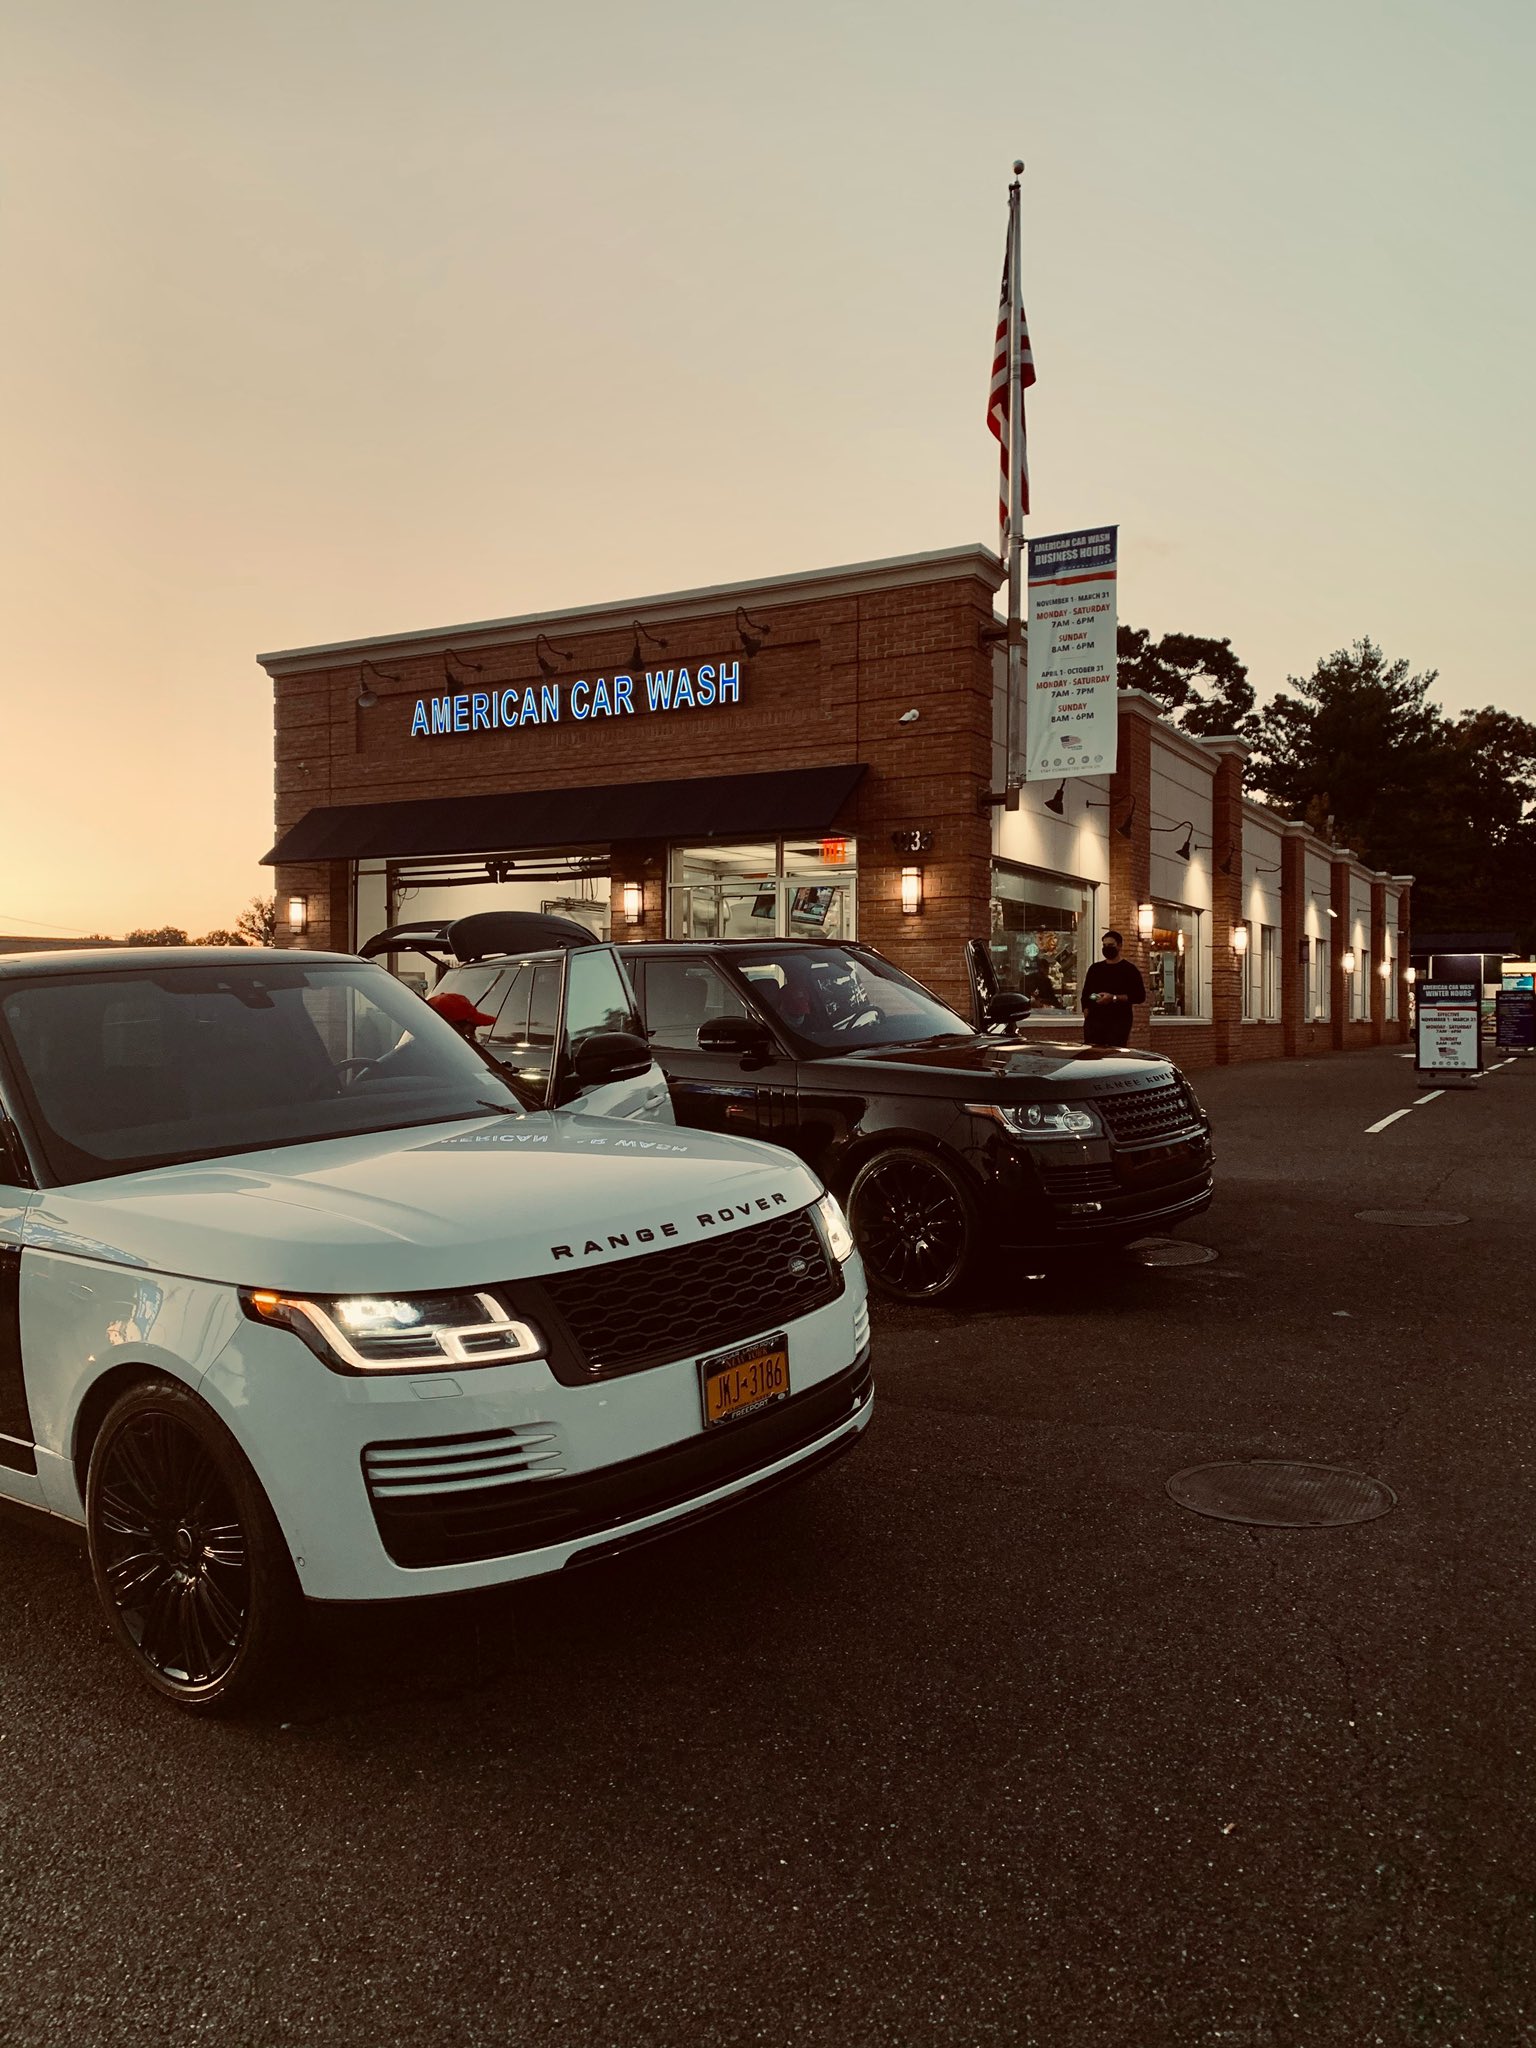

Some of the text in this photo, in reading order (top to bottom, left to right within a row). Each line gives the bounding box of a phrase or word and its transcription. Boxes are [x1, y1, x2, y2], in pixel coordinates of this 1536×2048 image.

[1034, 532, 1110, 552] AMERICAN CAR WASH
[1035, 544, 1111, 565] BUSINESS HOURS
[1036, 596, 1069, 607] NOVEMBER
[1078, 592, 1100, 601] MARCH
[1036, 609, 1068, 620] MONDAY
[1073, 603, 1110, 615] SATURDAY
[1051, 620, 1070, 628] 7AM
[1076, 616, 1094, 625] 6PM
[1058, 632, 1088, 642] SUNDAY
[1052, 644, 1070, 653] 8AM
[1076, 641, 1095, 650] 6PM
[1067, 666, 1094, 675] OCTOBER
[1036, 680, 1068, 690] MONDAY
[1072, 675, 1110, 686] SATURDAY
[410, 661, 740, 736] AMERICAN CAR WASH
[1051, 690, 1069, 698] 7AM
[1076, 687, 1094, 696] 7PM
[1058, 703, 1087, 712] SUNDAY
[1051, 715, 1069, 723] 8AM
[1076, 712, 1094, 720] 6PM
[1093, 1080, 1141, 1091] RANGE
[550, 1192, 788, 1260] RANGE ROVER
[742, 1344, 760, 1354] LAND
[732, 1399, 768, 1419] FREEPORT
